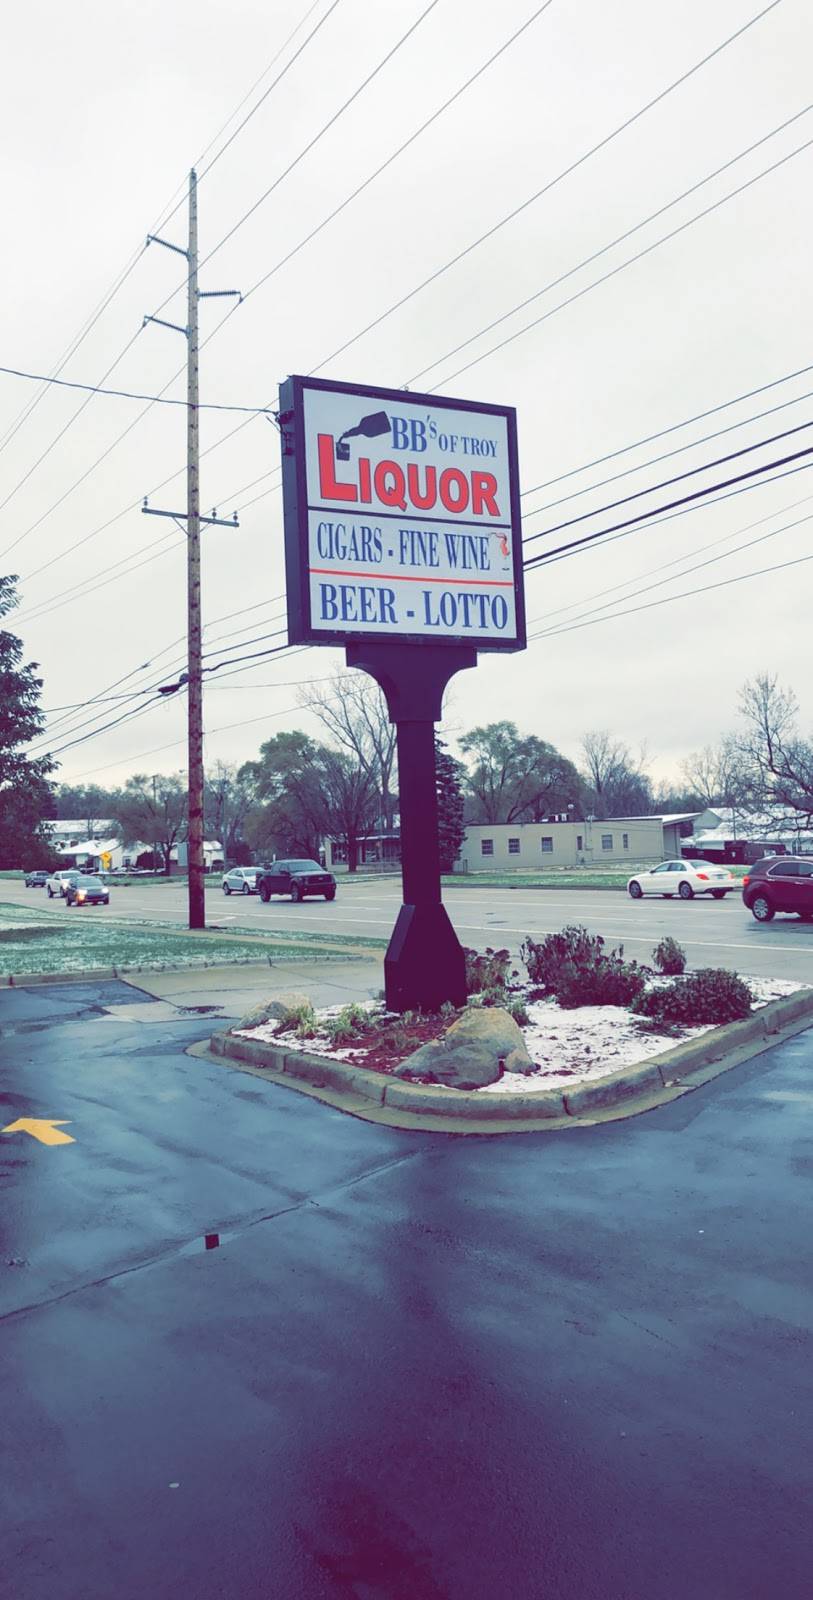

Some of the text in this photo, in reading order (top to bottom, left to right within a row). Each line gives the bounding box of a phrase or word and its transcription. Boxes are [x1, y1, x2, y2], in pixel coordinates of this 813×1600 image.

[438, 434, 459, 453] OF
[460, 437, 498, 458] TROY
[317, 433, 501, 517] LIQUOR
[316, 521, 383, 564] CIGARS
[398, 529, 440, 567] FINE
[444, 532, 491, 571] WINE
[319, 583, 398, 624] BEER
[423, 590, 508, 630] LOTTO
